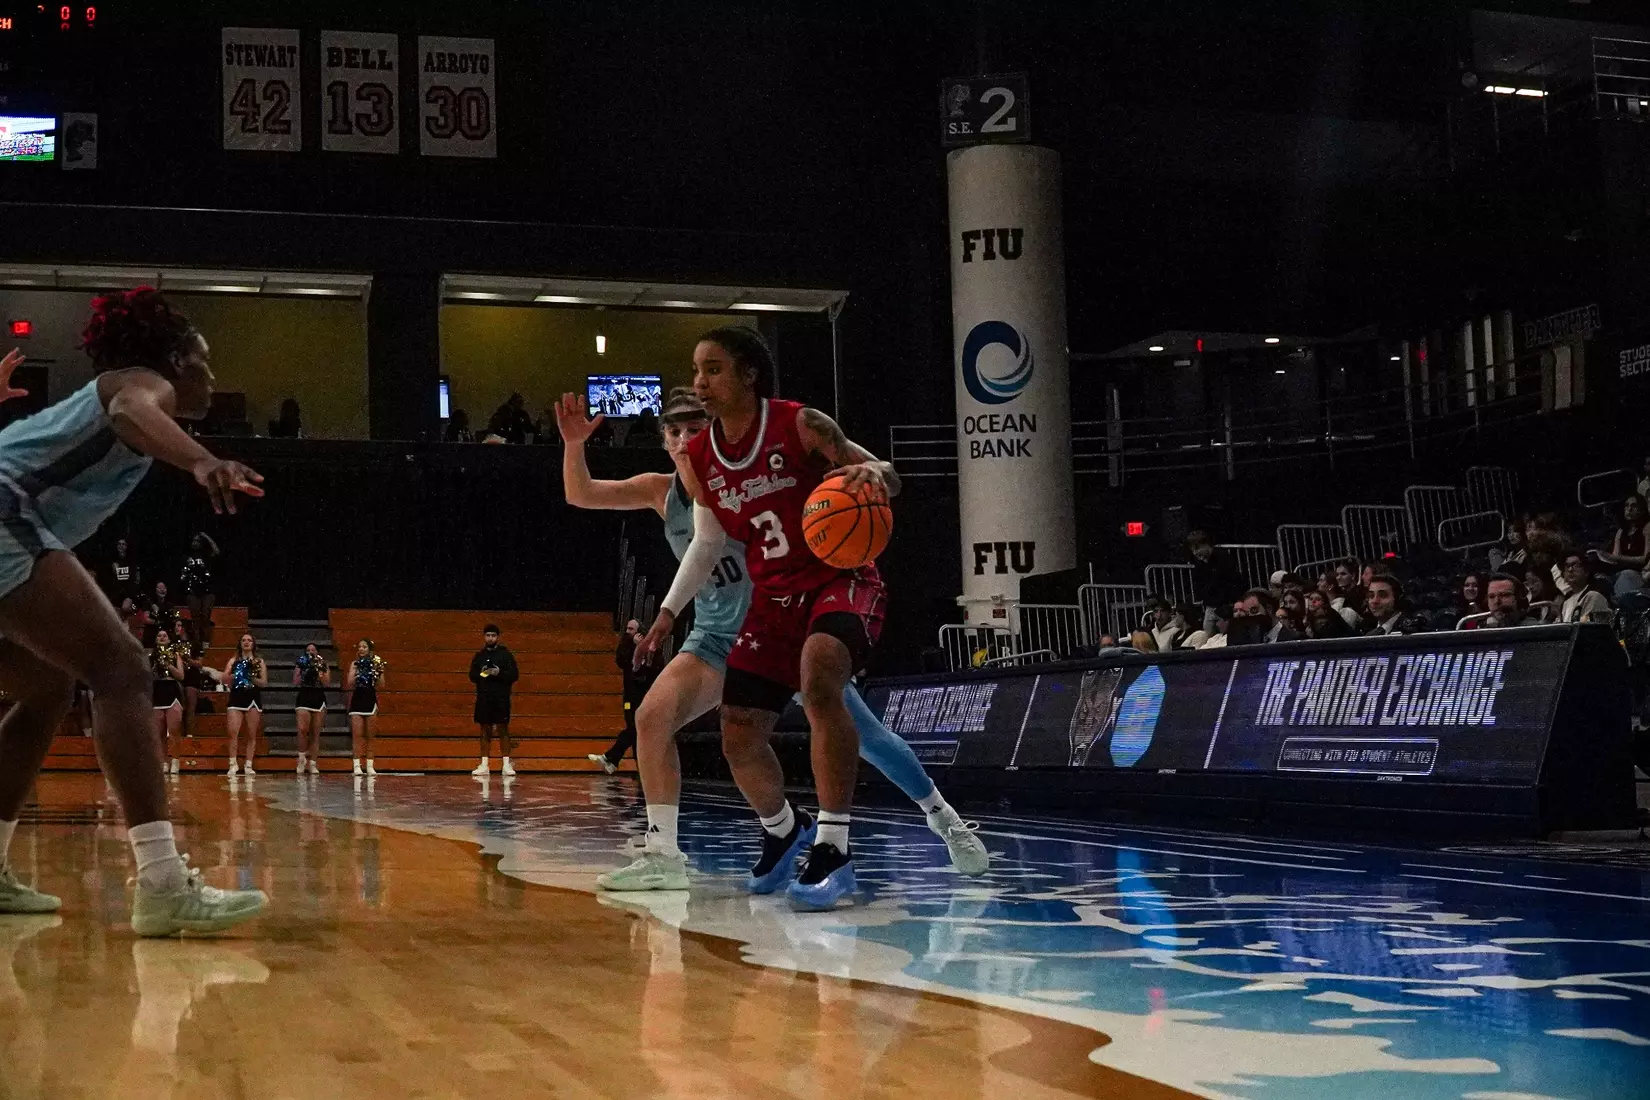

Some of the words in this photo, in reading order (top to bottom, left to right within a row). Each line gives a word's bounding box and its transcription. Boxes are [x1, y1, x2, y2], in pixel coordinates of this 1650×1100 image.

[226, 43, 296, 68] STEWART
[327, 47, 393, 70] BELL
[424, 52, 490, 74] ARROYO
[229, 78, 291, 134] 42
[326, 80, 393, 136] 13
[425, 86, 491, 140] 30
[948, 121, 974, 134] S.E.
[979, 86, 1016, 133] 2
[961, 228, 1024, 263] FIU
[964, 414, 1037, 434] OCEAN
[970, 438, 1032, 459] BANK
[750, 510, 790, 560] 3
[973, 541, 1036, 575] FIU
[1254, 660, 1300, 726] THE
[1288, 656, 1390, 726] PANTHER
[1378, 650, 1515, 726] EXCHANGE
[1283, 748, 1323, 761] CONNECTING
[1324, 749, 1342, 761] WITH
[1343, 749, 1359, 762] FIU
